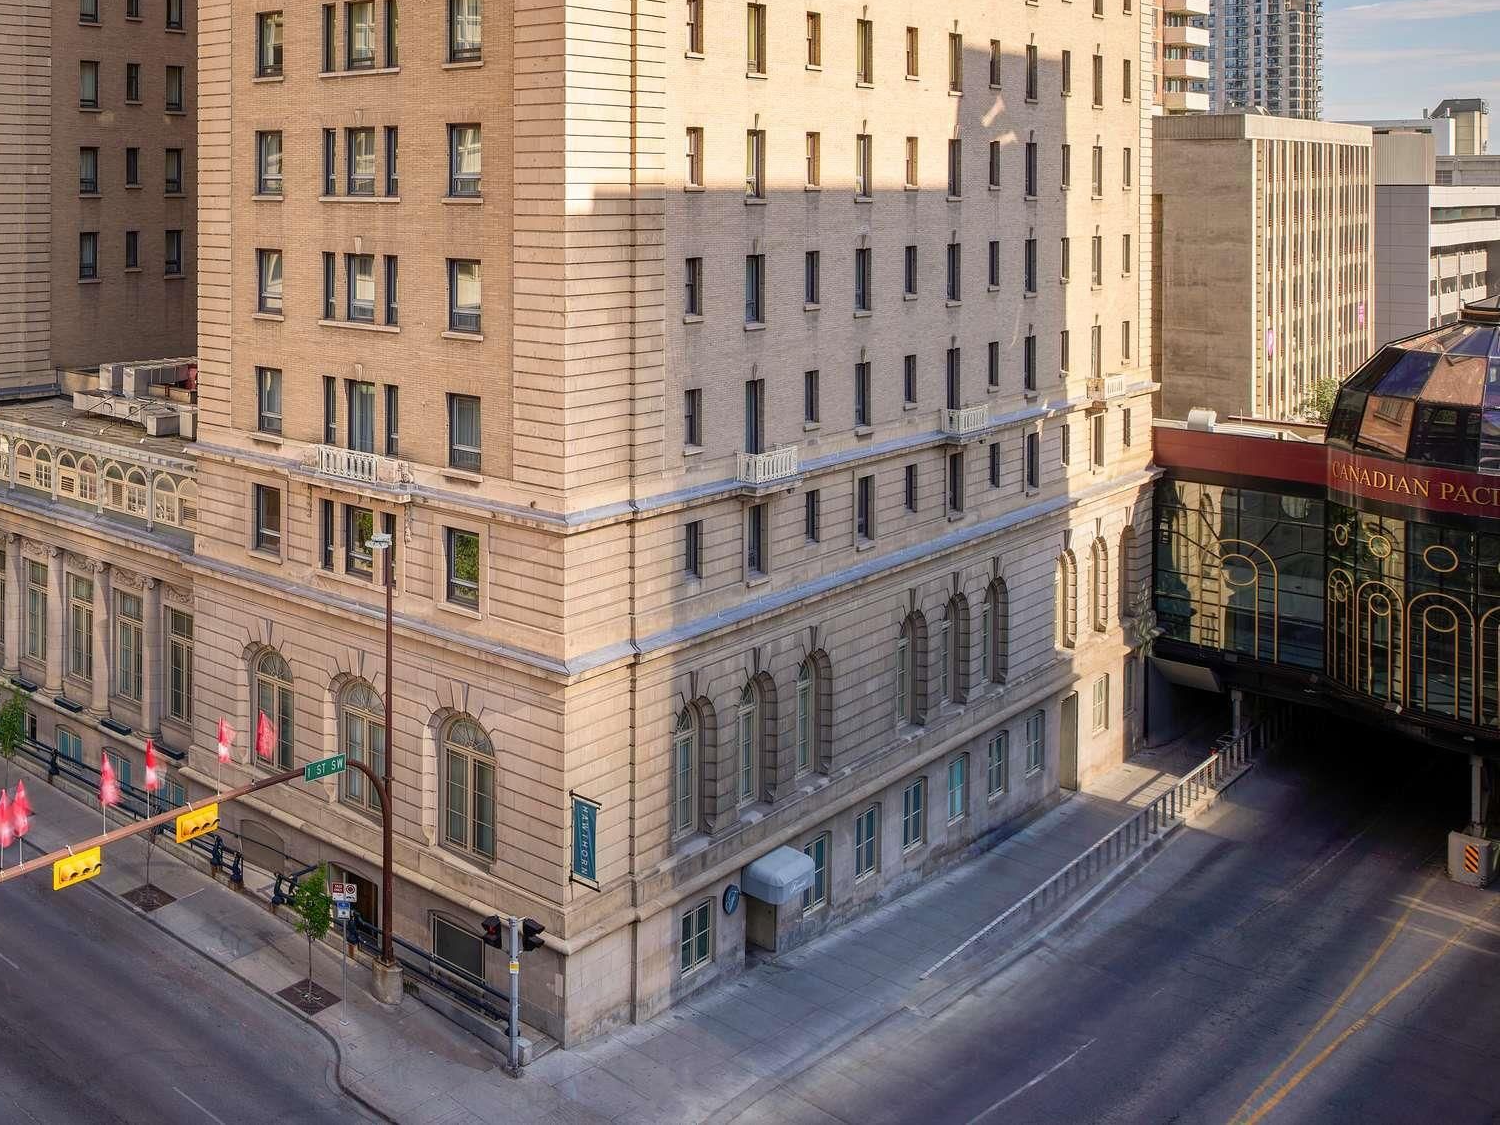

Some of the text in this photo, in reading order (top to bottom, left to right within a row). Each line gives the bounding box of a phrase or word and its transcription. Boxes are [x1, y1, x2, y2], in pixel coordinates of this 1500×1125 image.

[1332, 460, 1431, 498] CANADIAN
[316, 762, 326, 775] ST
[331, 757, 344, 771] SW
[581, 805, 589, 875] HAWTHORN
